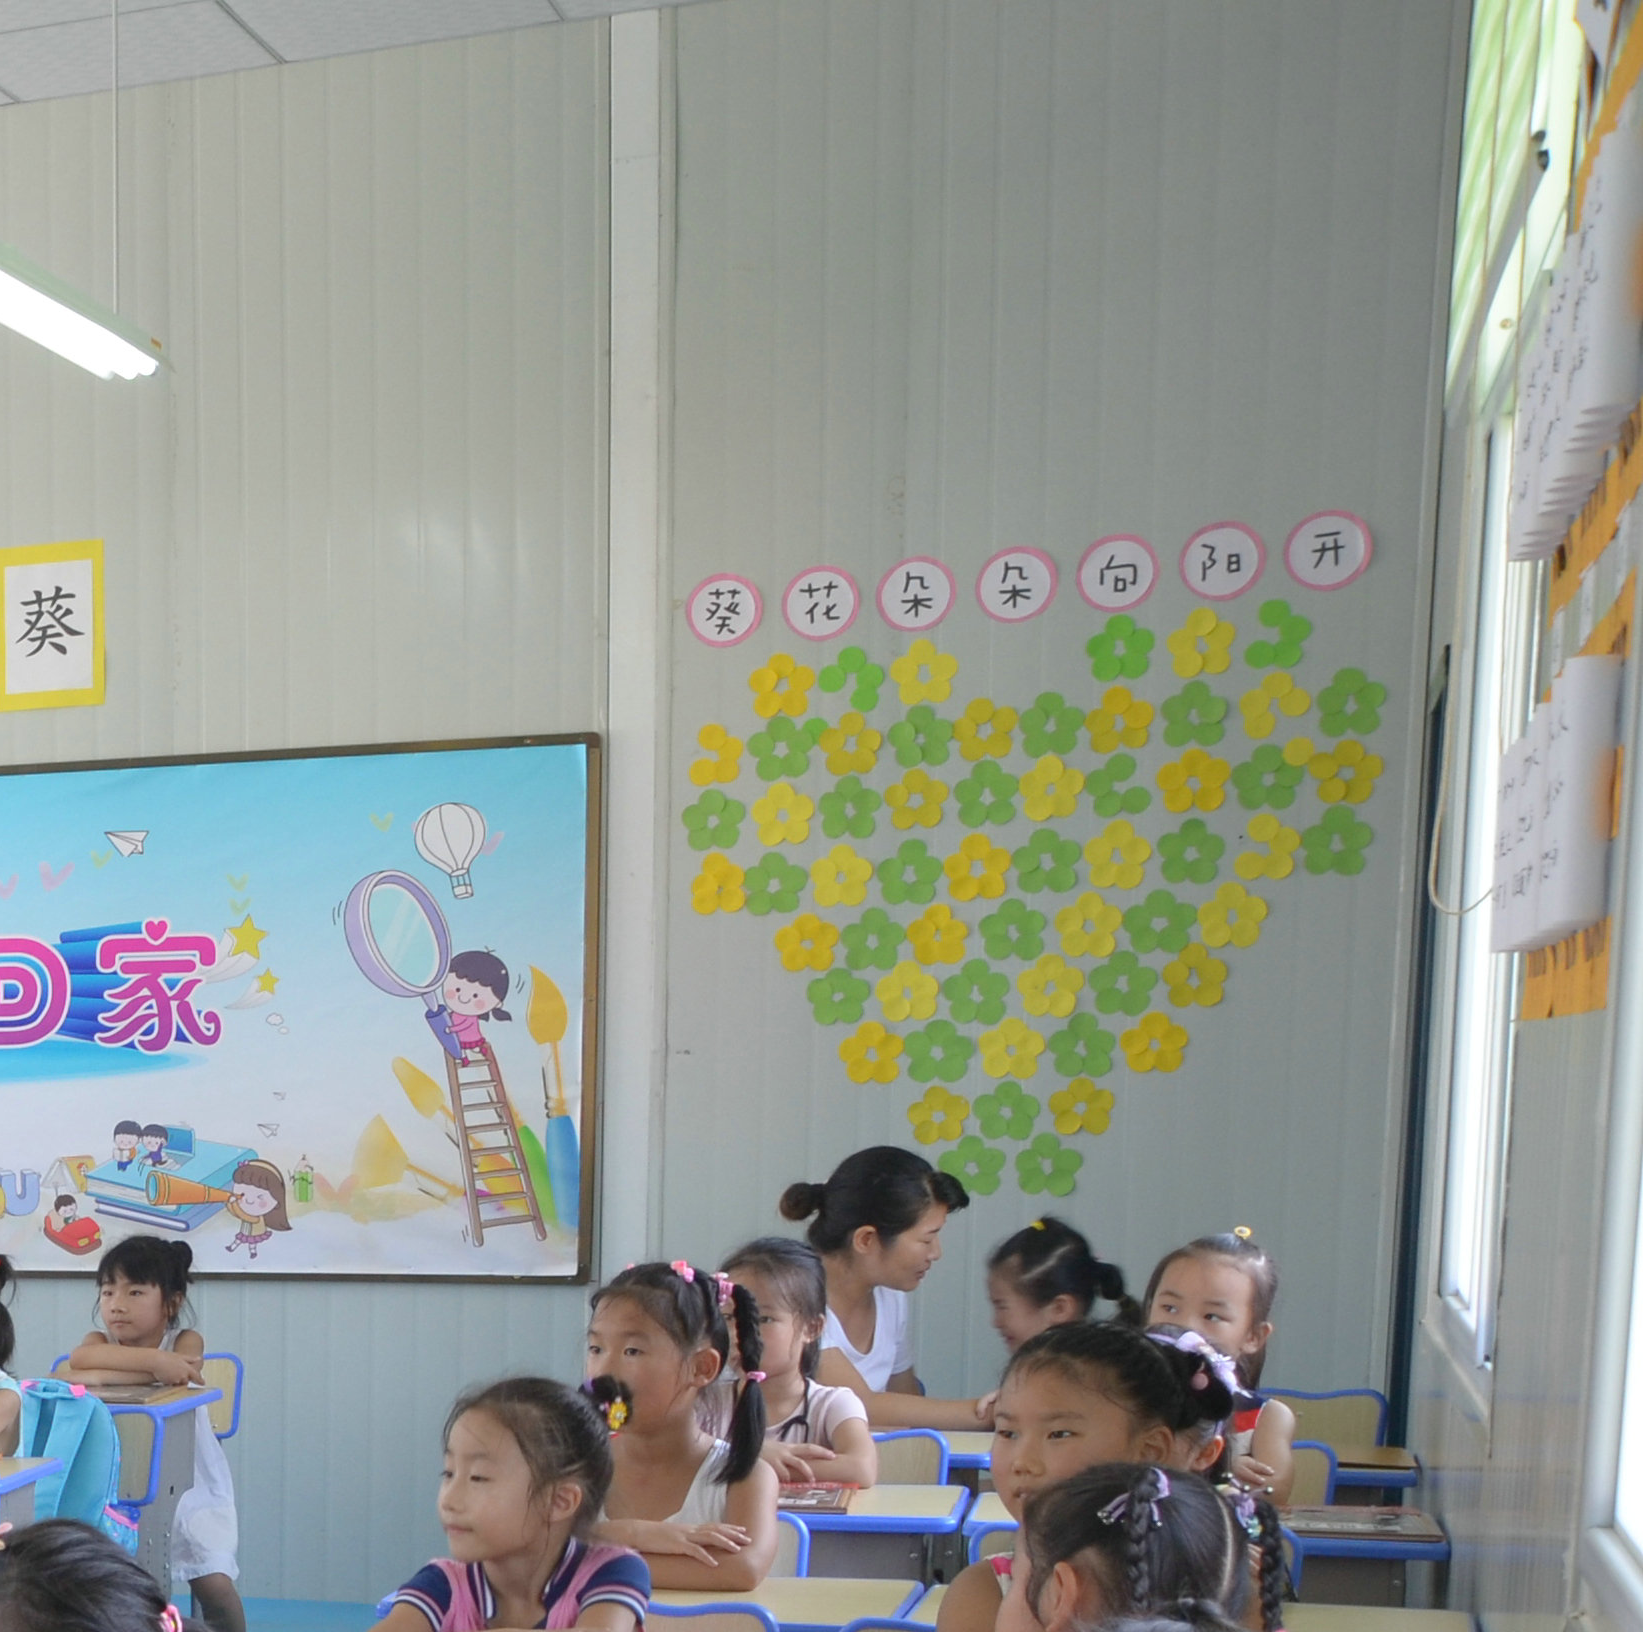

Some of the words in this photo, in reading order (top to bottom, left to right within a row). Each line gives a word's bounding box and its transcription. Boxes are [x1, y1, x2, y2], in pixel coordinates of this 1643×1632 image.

[15, 585, 85, 658] 葵
[704, 530, 1347, 636] 葵花朵朵向阳开
